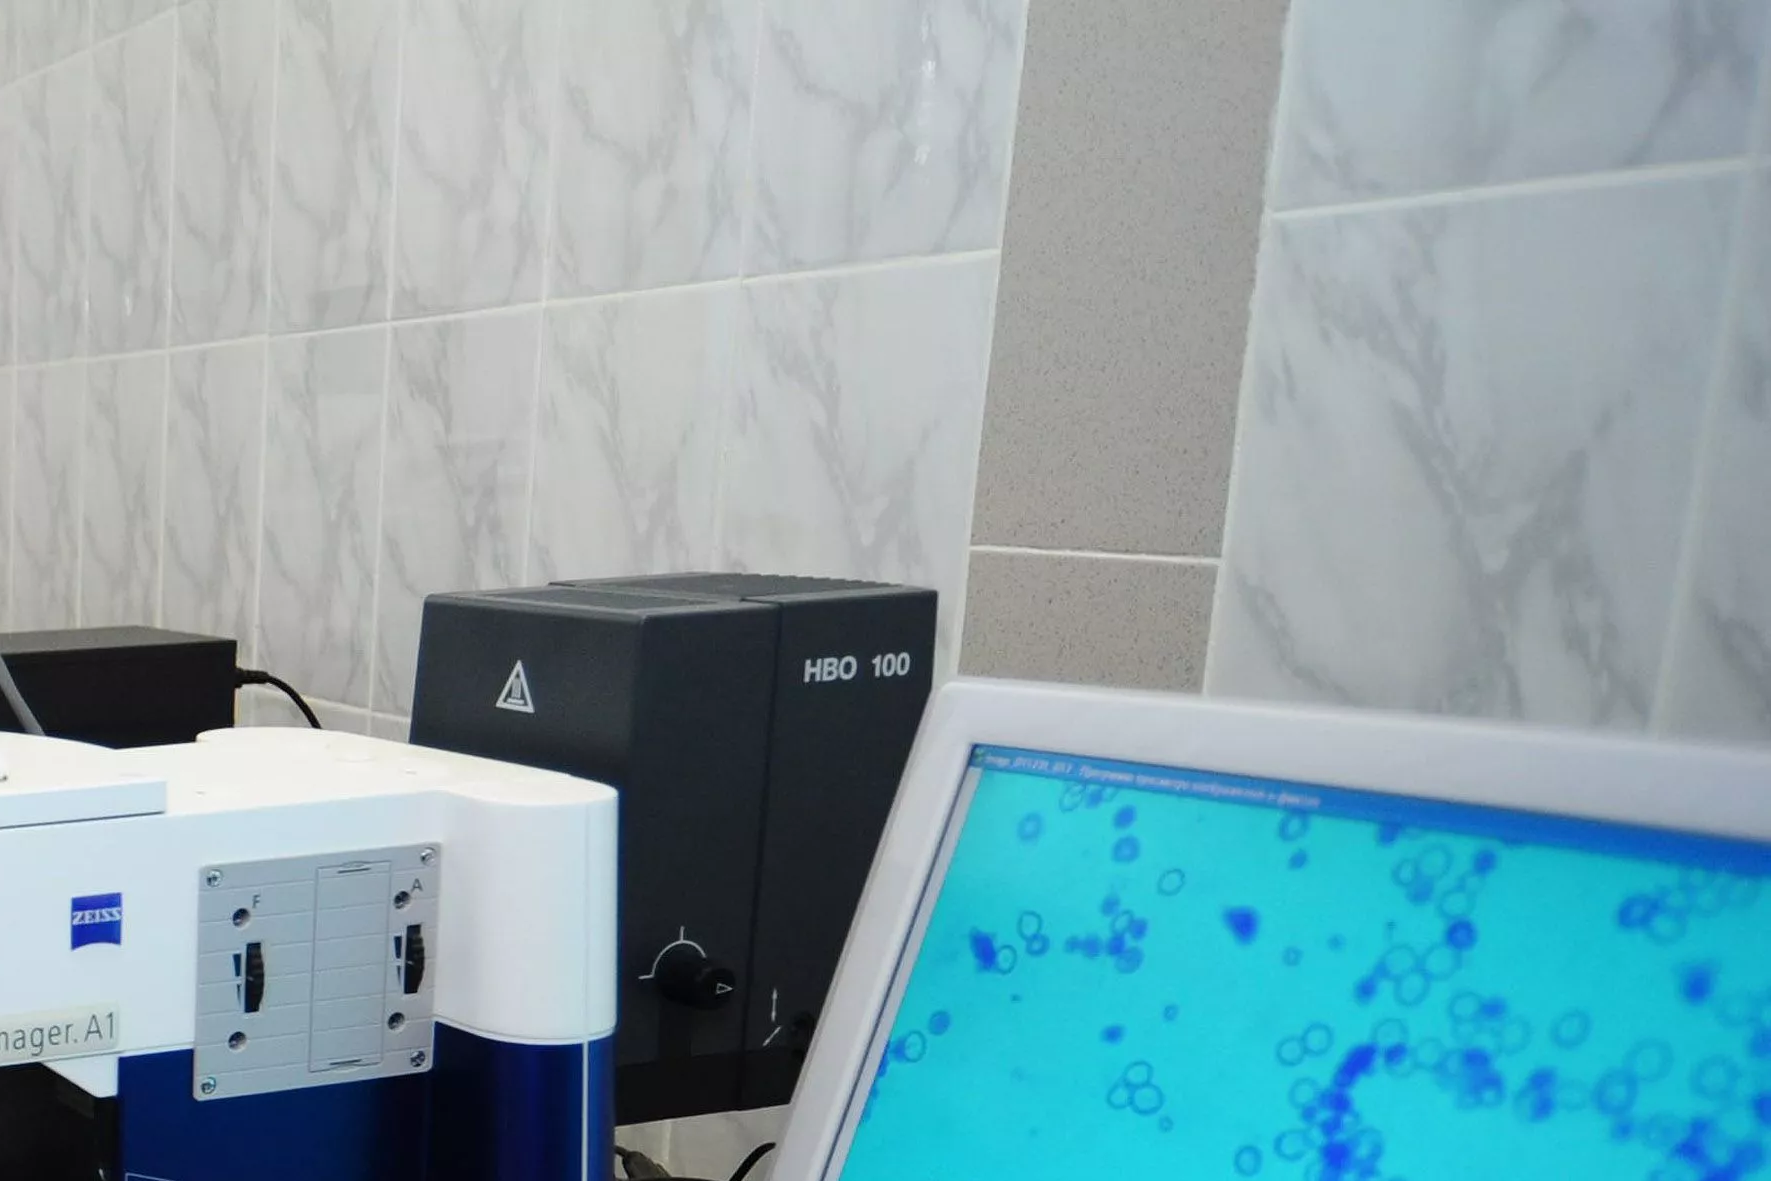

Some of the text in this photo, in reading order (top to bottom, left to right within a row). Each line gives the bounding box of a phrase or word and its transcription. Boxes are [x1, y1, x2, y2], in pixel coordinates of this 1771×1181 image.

[803, 651, 911, 683] HBO 100
[411, 878, 423, 892] A
[252, 894, 261, 909] F
[72, 907, 123, 926] ZEISS
